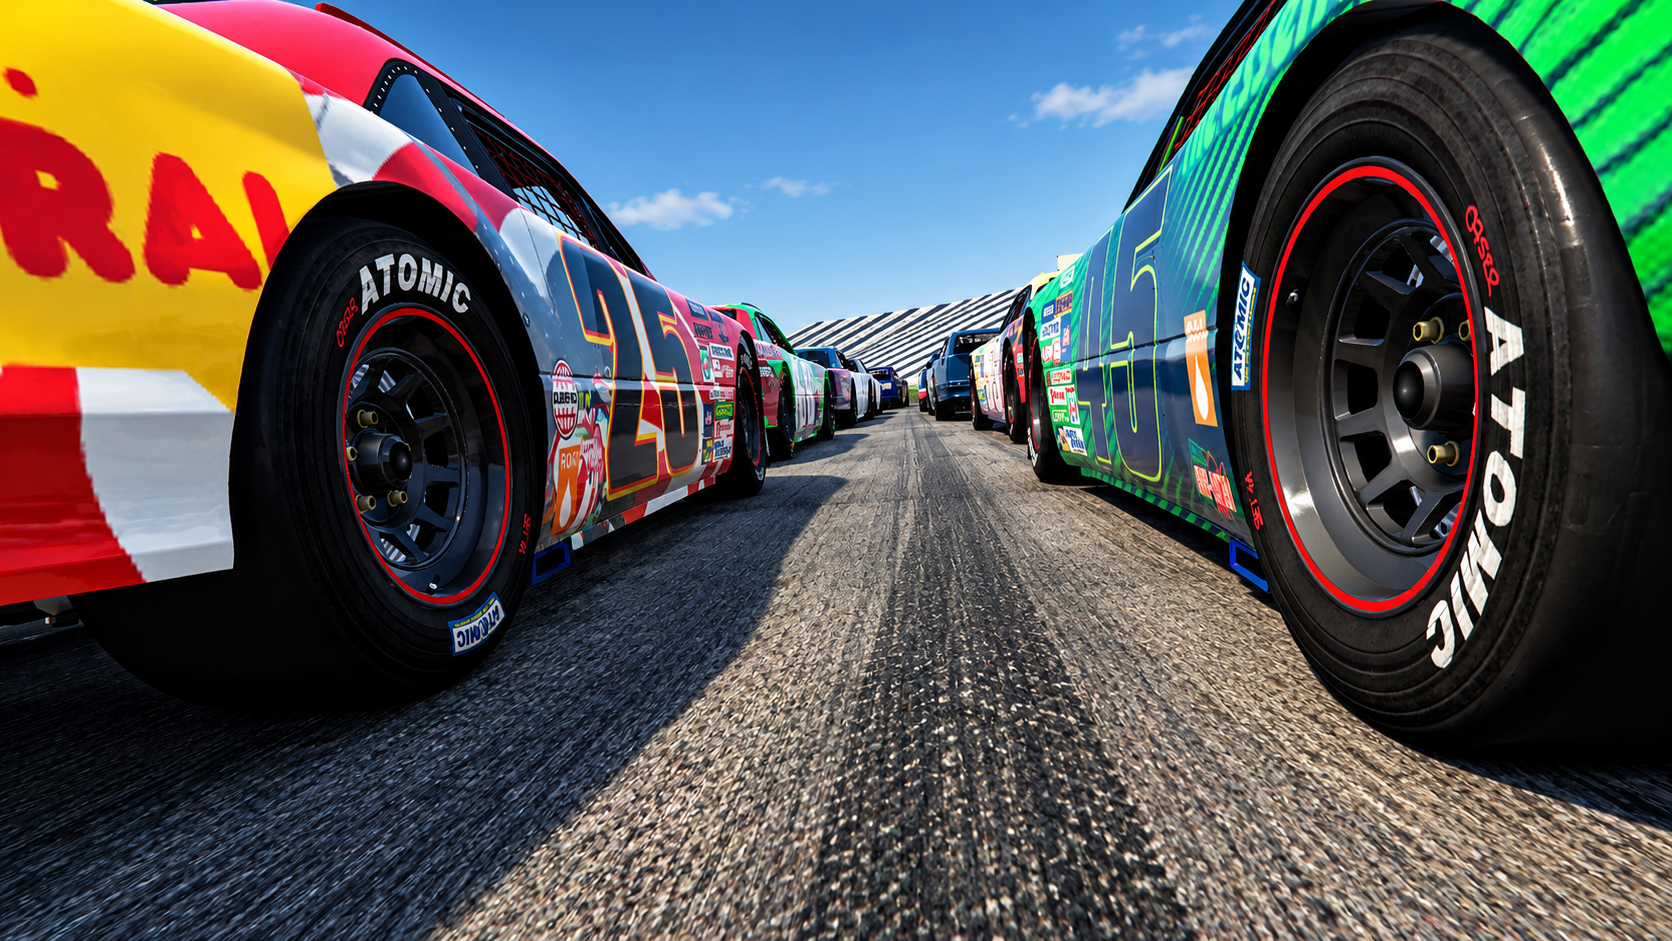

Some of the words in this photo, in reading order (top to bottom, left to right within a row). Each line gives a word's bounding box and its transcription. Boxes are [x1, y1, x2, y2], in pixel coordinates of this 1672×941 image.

[359, 253, 471, 316] ATOMIC
[557, 232, 700, 501] 25
[1232, 276, 1250, 381] ATOMIC
[1425, 305, 1526, 669] ATOMIC
